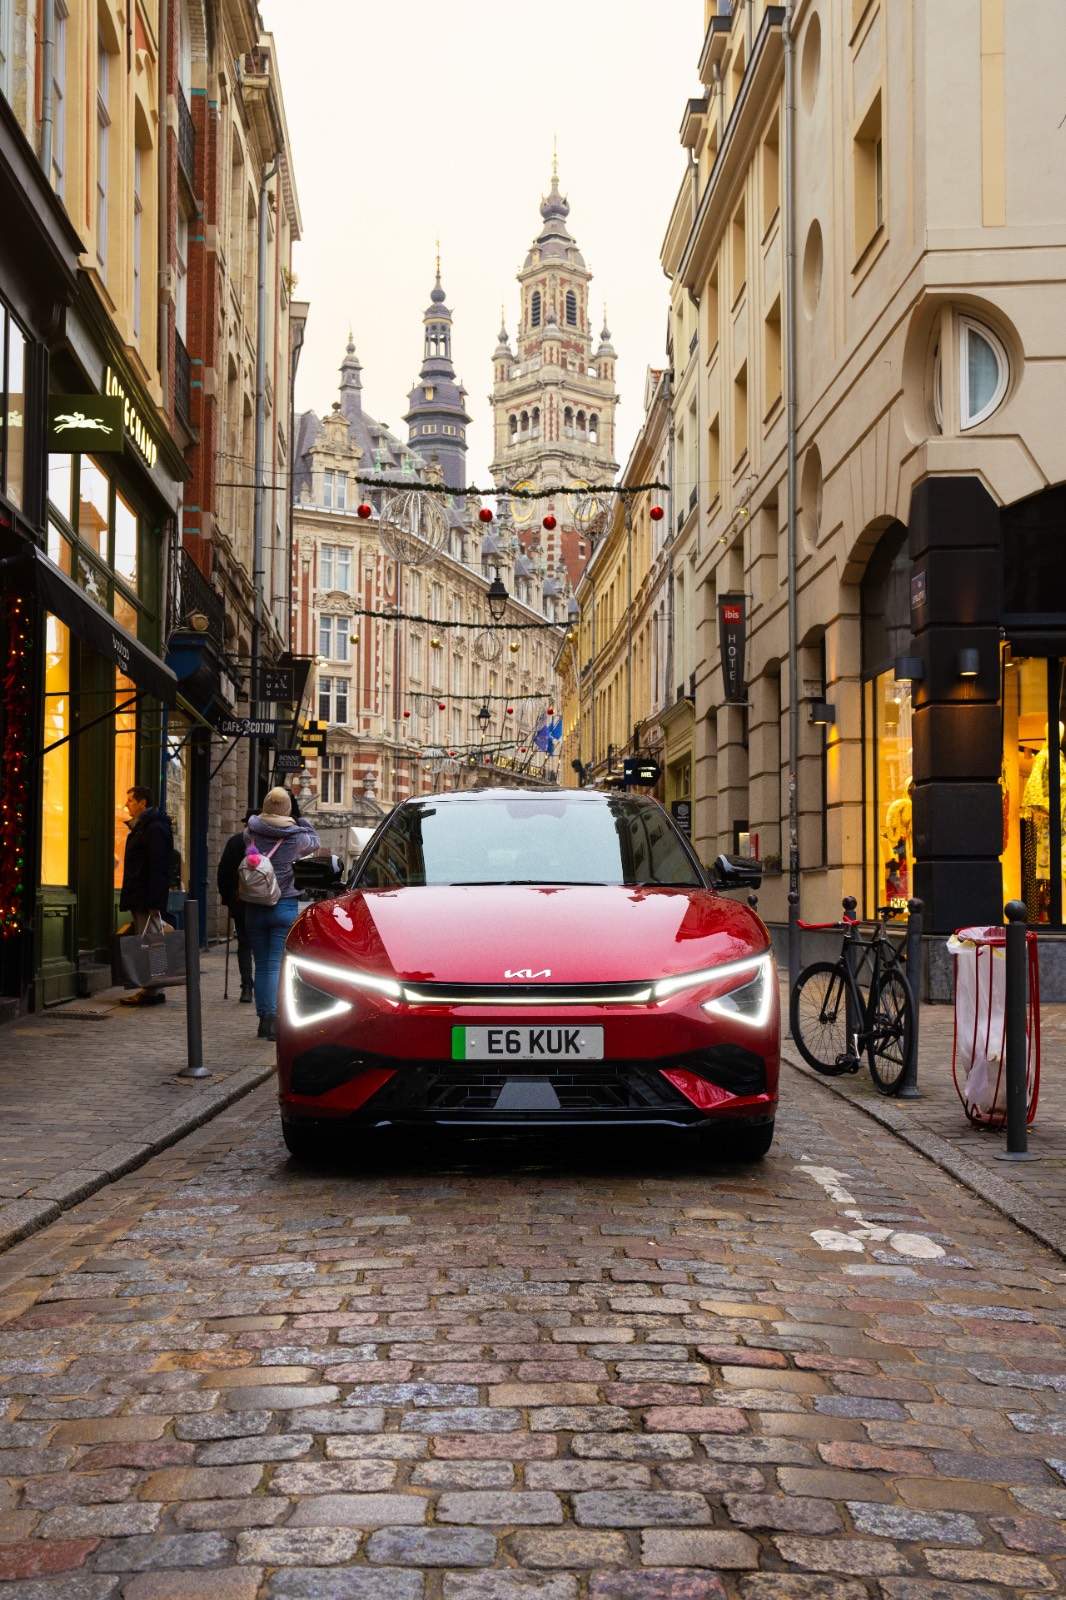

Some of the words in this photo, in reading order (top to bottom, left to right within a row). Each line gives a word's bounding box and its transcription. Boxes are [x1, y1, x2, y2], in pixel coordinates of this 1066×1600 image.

[725, 610, 739, 619] ibis
[250, 722, 275, 734] COTON
[487, 1029, 521, 1054] E6
[529, 1029, 581, 1054] KUK
